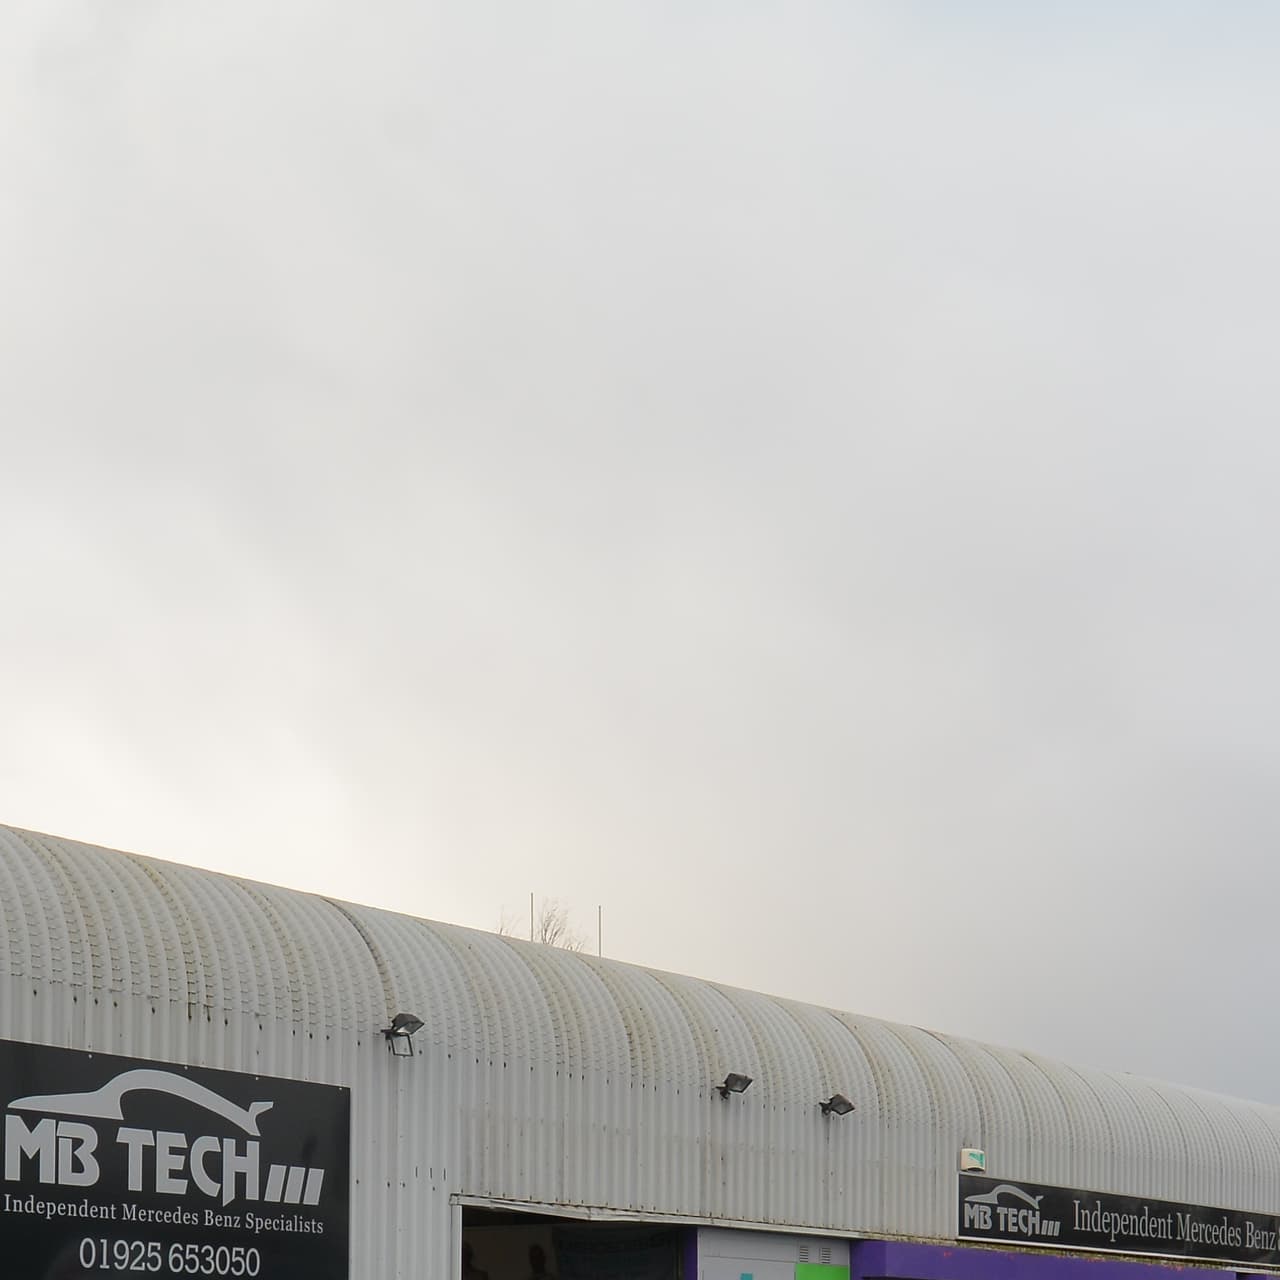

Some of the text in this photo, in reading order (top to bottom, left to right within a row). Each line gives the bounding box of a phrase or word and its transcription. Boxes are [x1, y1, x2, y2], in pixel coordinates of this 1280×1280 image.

[4, 1114, 261, 1207] MB TECH
[4, 1194, 324, 1234] Independent Mercedes Benz Specialists
[964, 1203, 1040, 1237] MB TECH
[1073, 1200, 1173, 1242] Independent
[1177, 1212, 1241, 1247] Mercedes
[1246, 1221, 1276, 1251] Benz
[79, 1237, 261, 1276] 01925 653050
